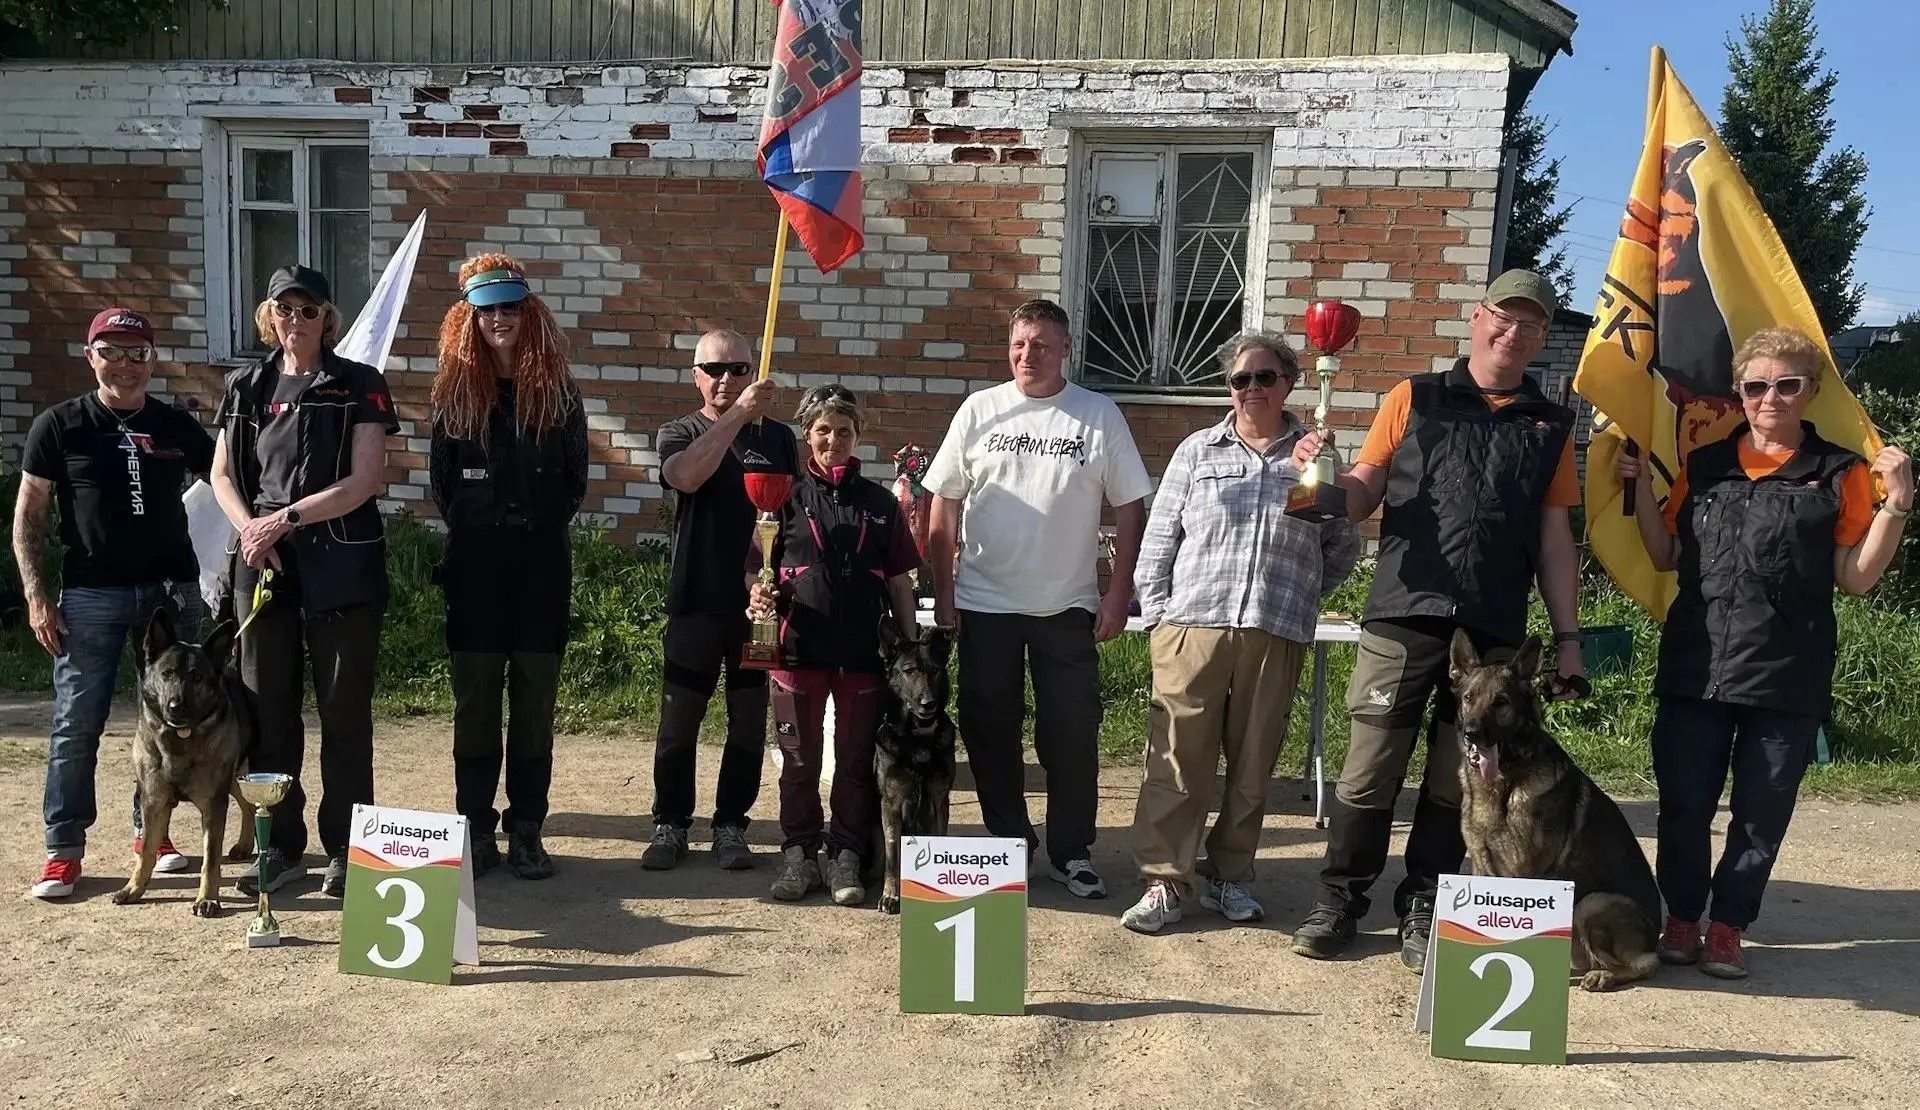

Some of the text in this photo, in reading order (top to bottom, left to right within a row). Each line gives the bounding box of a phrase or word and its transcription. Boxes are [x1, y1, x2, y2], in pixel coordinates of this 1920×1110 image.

[380, 822, 450, 842] Diusapet
[382, 841, 429, 859] alleva
[933, 851, 1009, 869] Diusapet
[937, 870, 989, 886] alleva
[1474, 891, 1556, 911] Diusapet
[366, 877, 426, 969] 3
[1477, 911, 1533, 930] alleva
[933, 906, 976, 1003] 1
[1465, 951, 1535, 1051] 2
